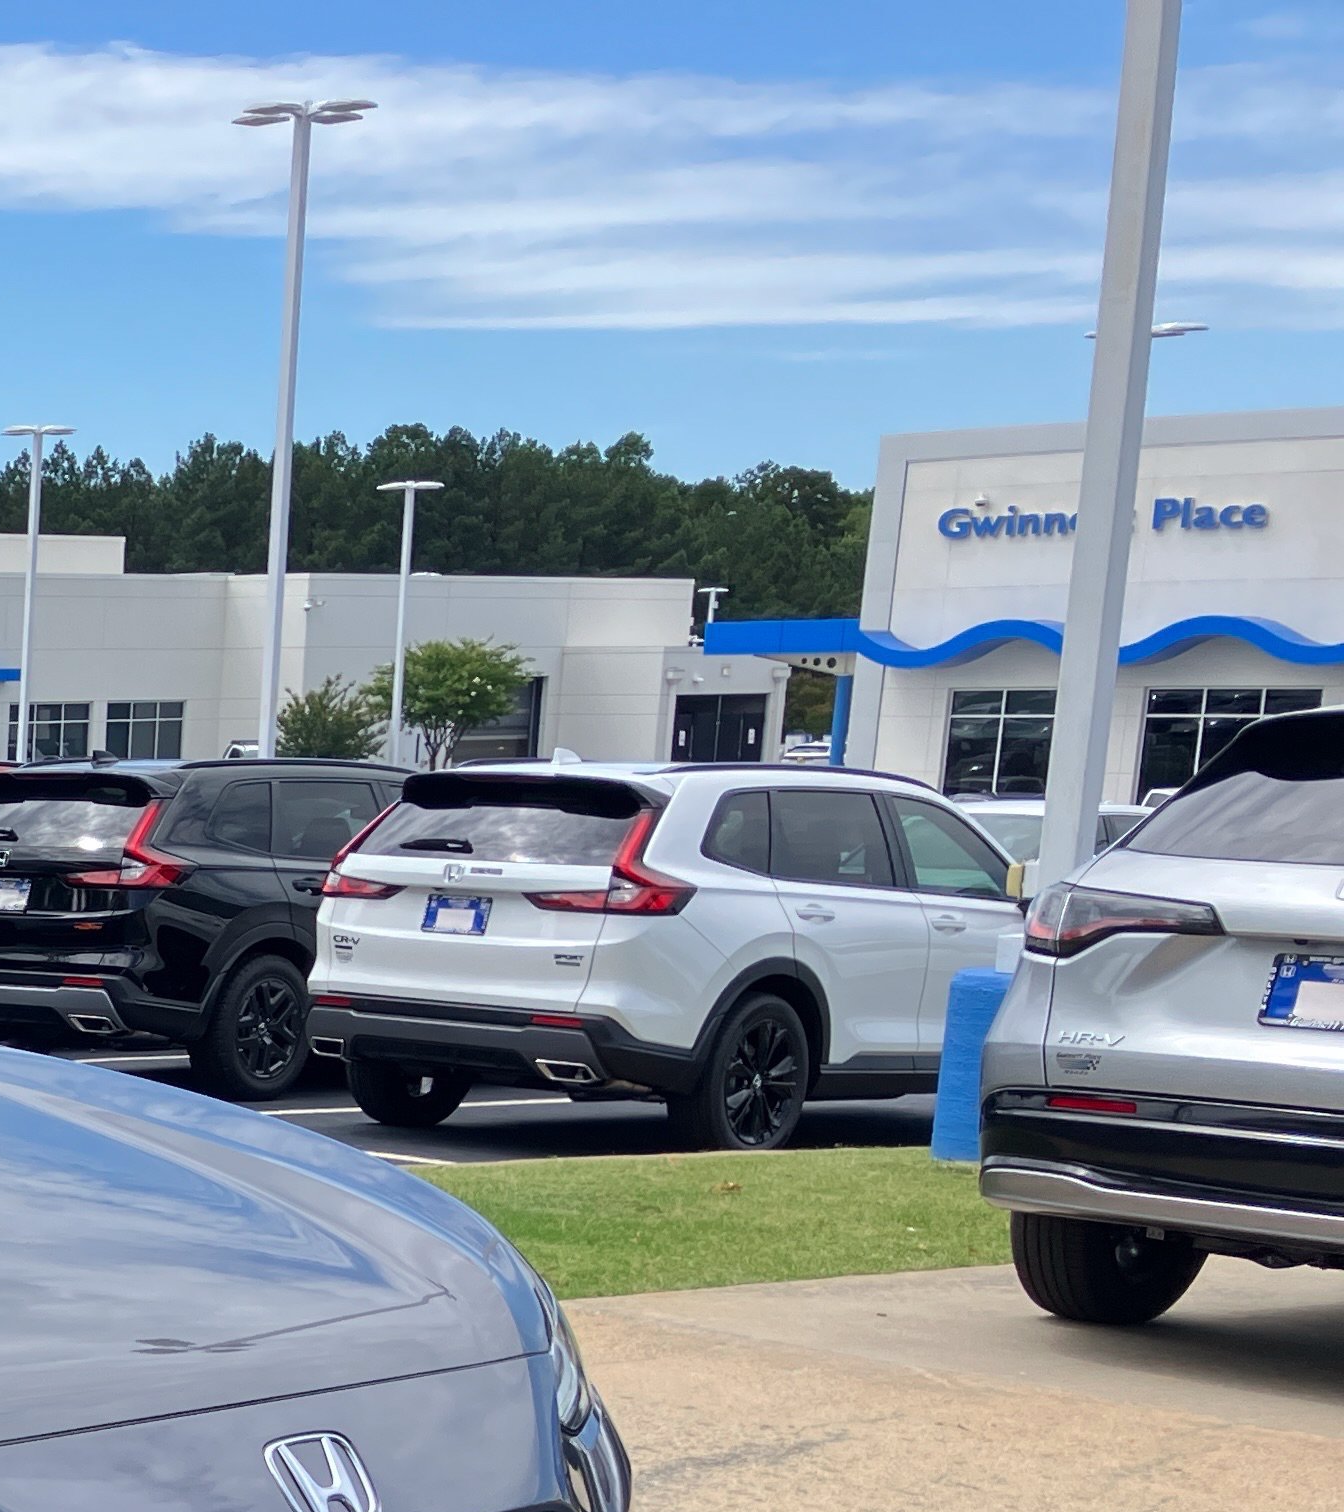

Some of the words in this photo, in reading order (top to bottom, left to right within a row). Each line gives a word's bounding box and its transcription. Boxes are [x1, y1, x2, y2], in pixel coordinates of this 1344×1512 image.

[938, 505, 1135, 538] Gwinn
[1152, 497, 1269, 530] Place
[333, 934, 360, 945] CR-V
[1058, 1030, 1126, 1047] HR-V
